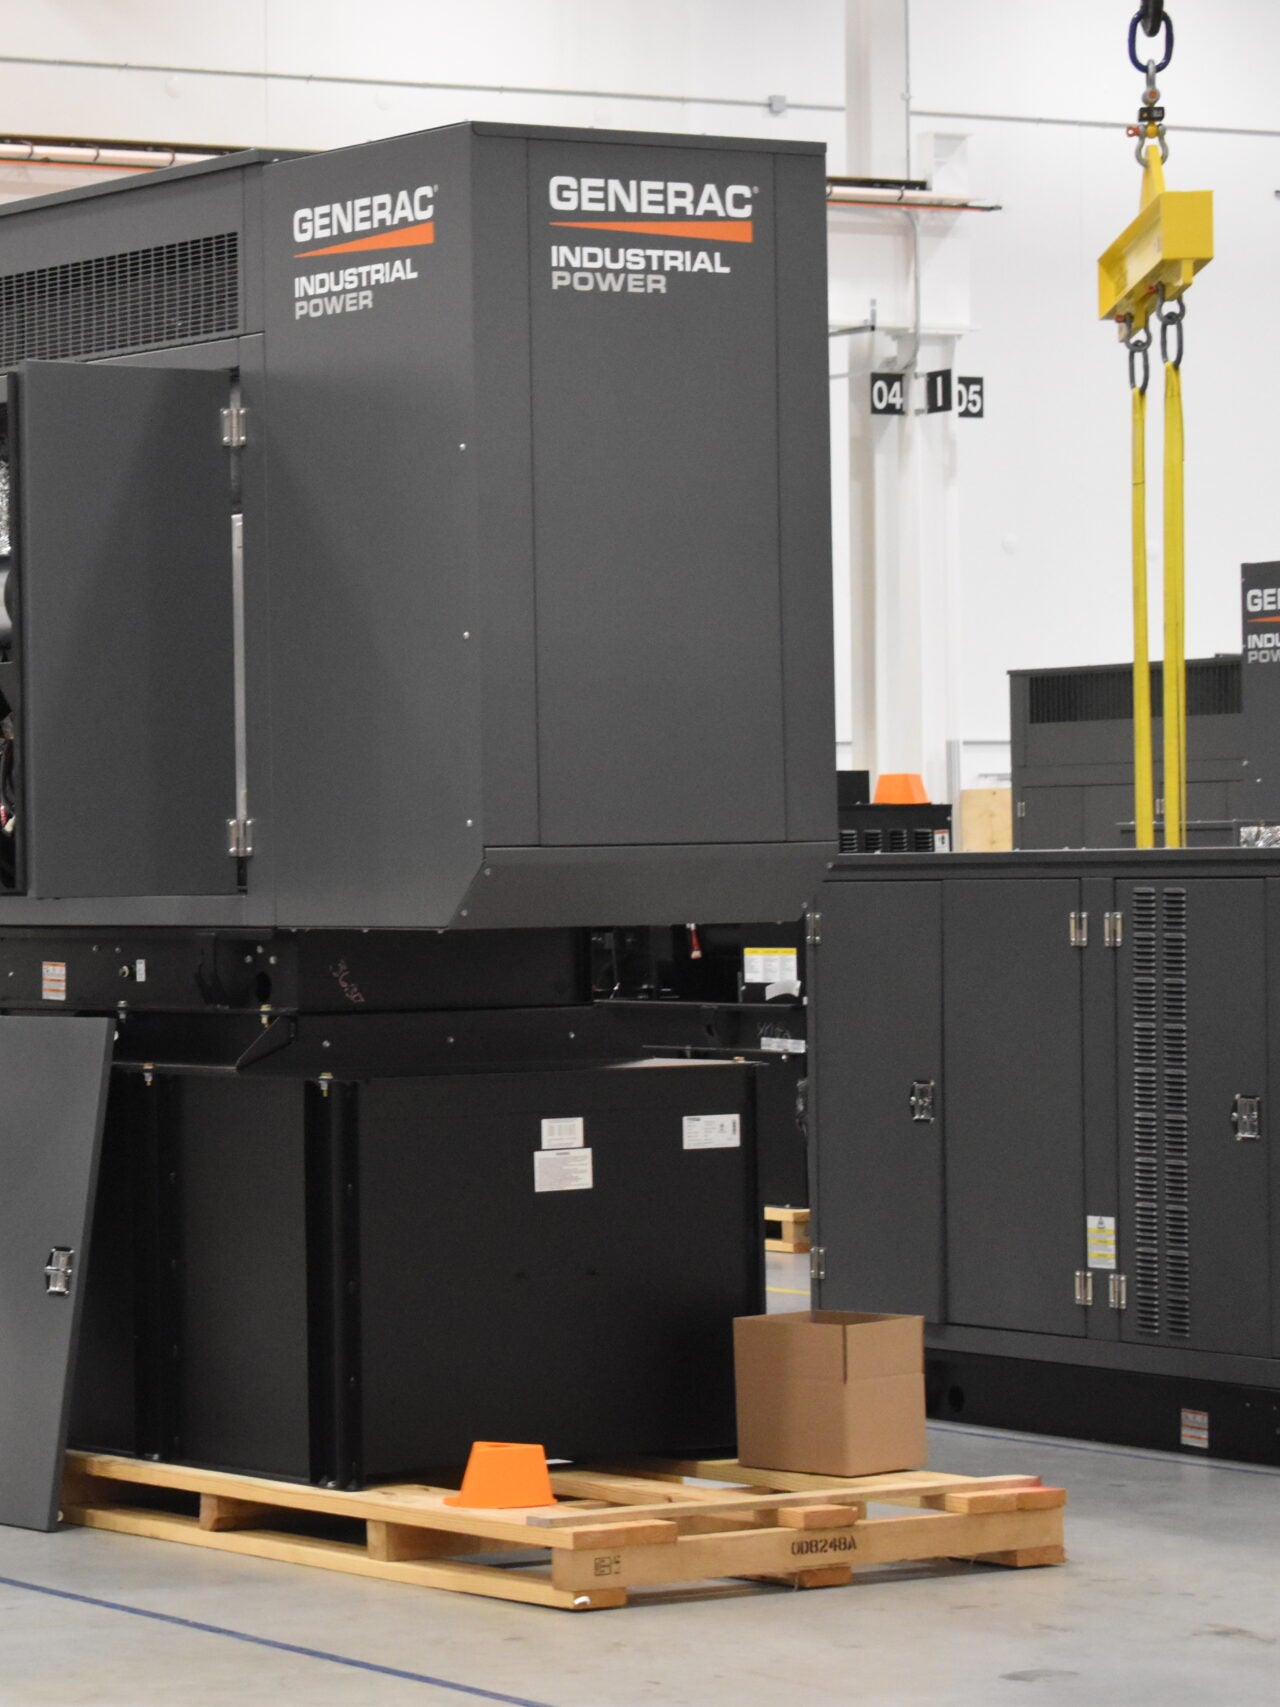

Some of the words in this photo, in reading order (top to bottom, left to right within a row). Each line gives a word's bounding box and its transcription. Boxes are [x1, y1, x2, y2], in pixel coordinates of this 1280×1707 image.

[549, 175, 752, 218] GENERAC
[293, 186, 434, 243] GENERAC
[551, 245, 731, 274] INDUSTRIAL
[294, 258, 418, 298] INDUSTRIAL
[551, 271, 667, 293] POWER
[295, 290, 373, 320] POWER
[872, 380, 903, 410] 04
[1246, 588, 1280, 612] GE
